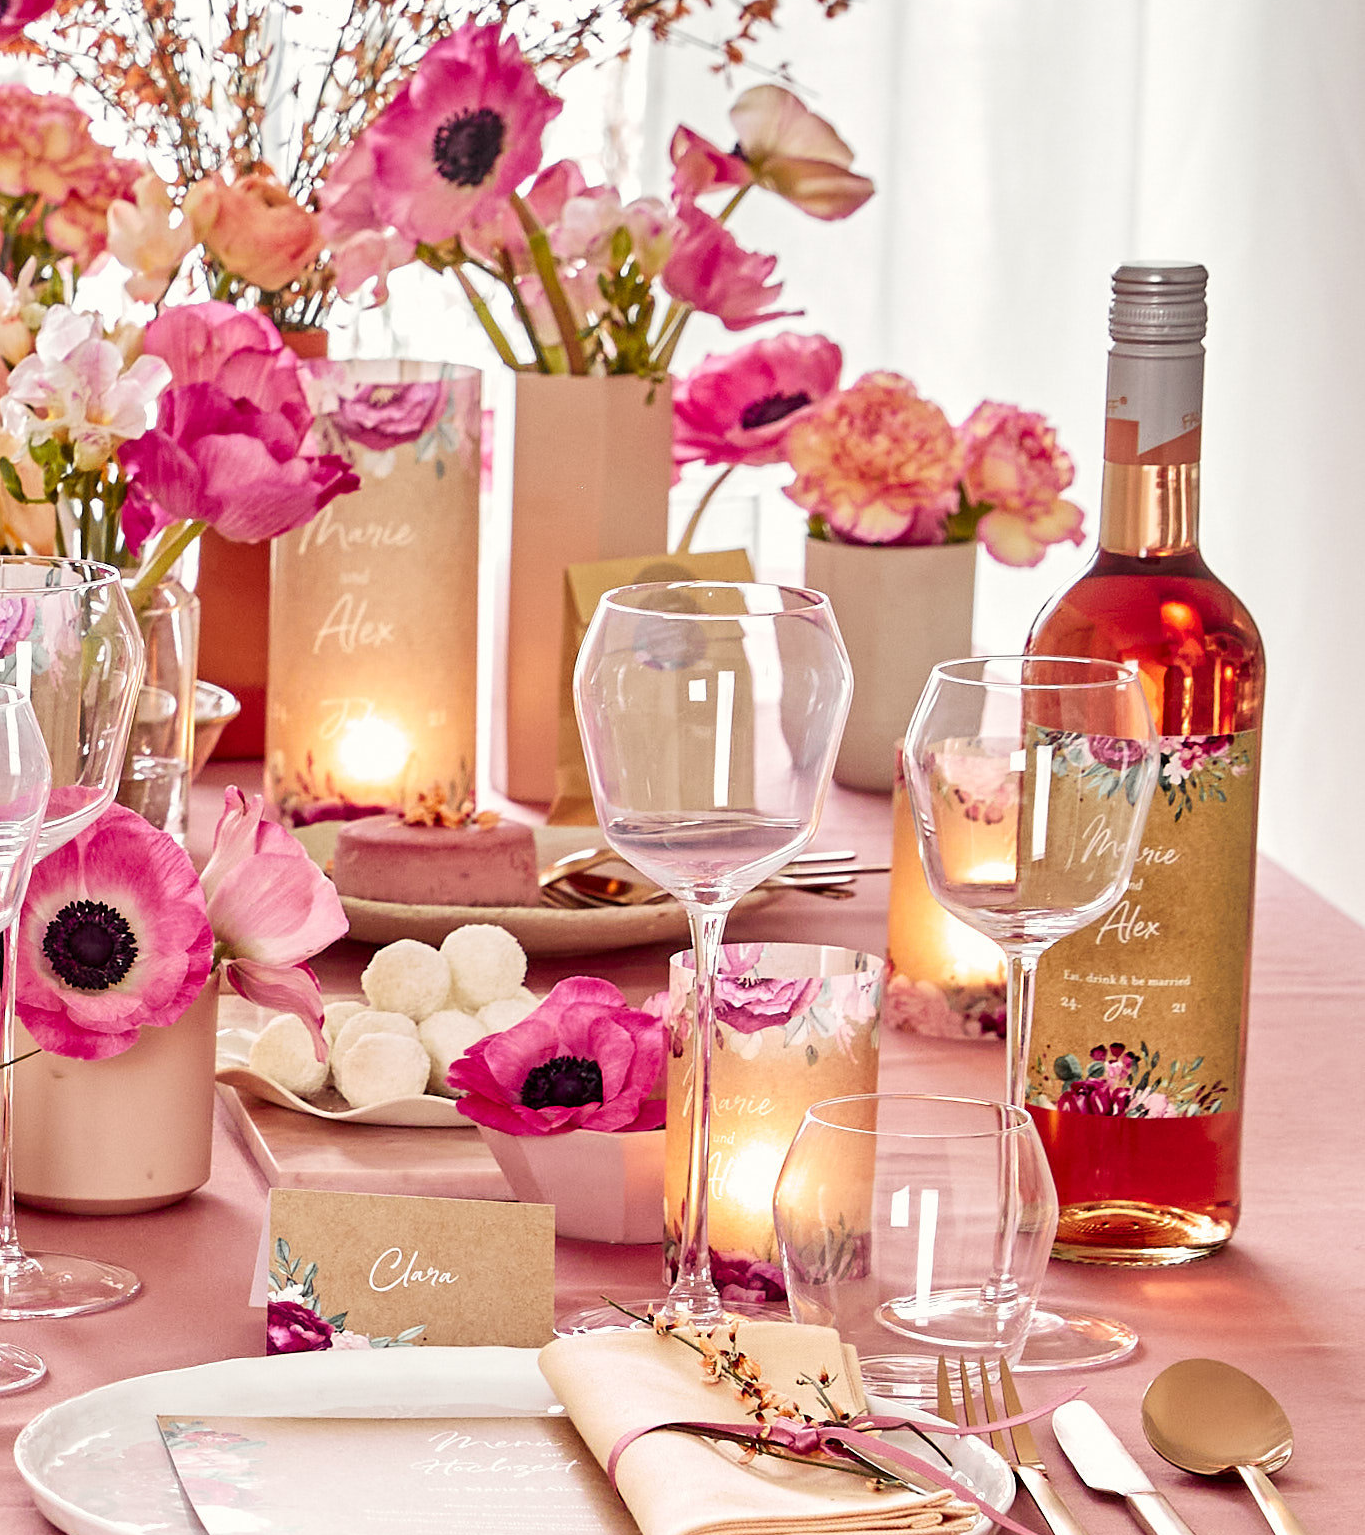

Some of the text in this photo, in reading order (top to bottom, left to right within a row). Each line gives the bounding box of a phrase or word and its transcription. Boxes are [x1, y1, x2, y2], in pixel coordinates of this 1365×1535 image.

[299, 505, 417, 555] Marie
[312, 592, 395, 655] Alex
[1095, 900, 1161, 945] Alex
[1086, 973, 1116, 986] drink
[1131, 976, 1145, 987] be
[1147, 976, 1192, 987] married
[1103, 994, 1144, 1022] Jul
[712, 1131, 736, 1146] und
[369, 1247, 459, 1292] Clara
[410, 1457, 582, 1478] Hochzeit
